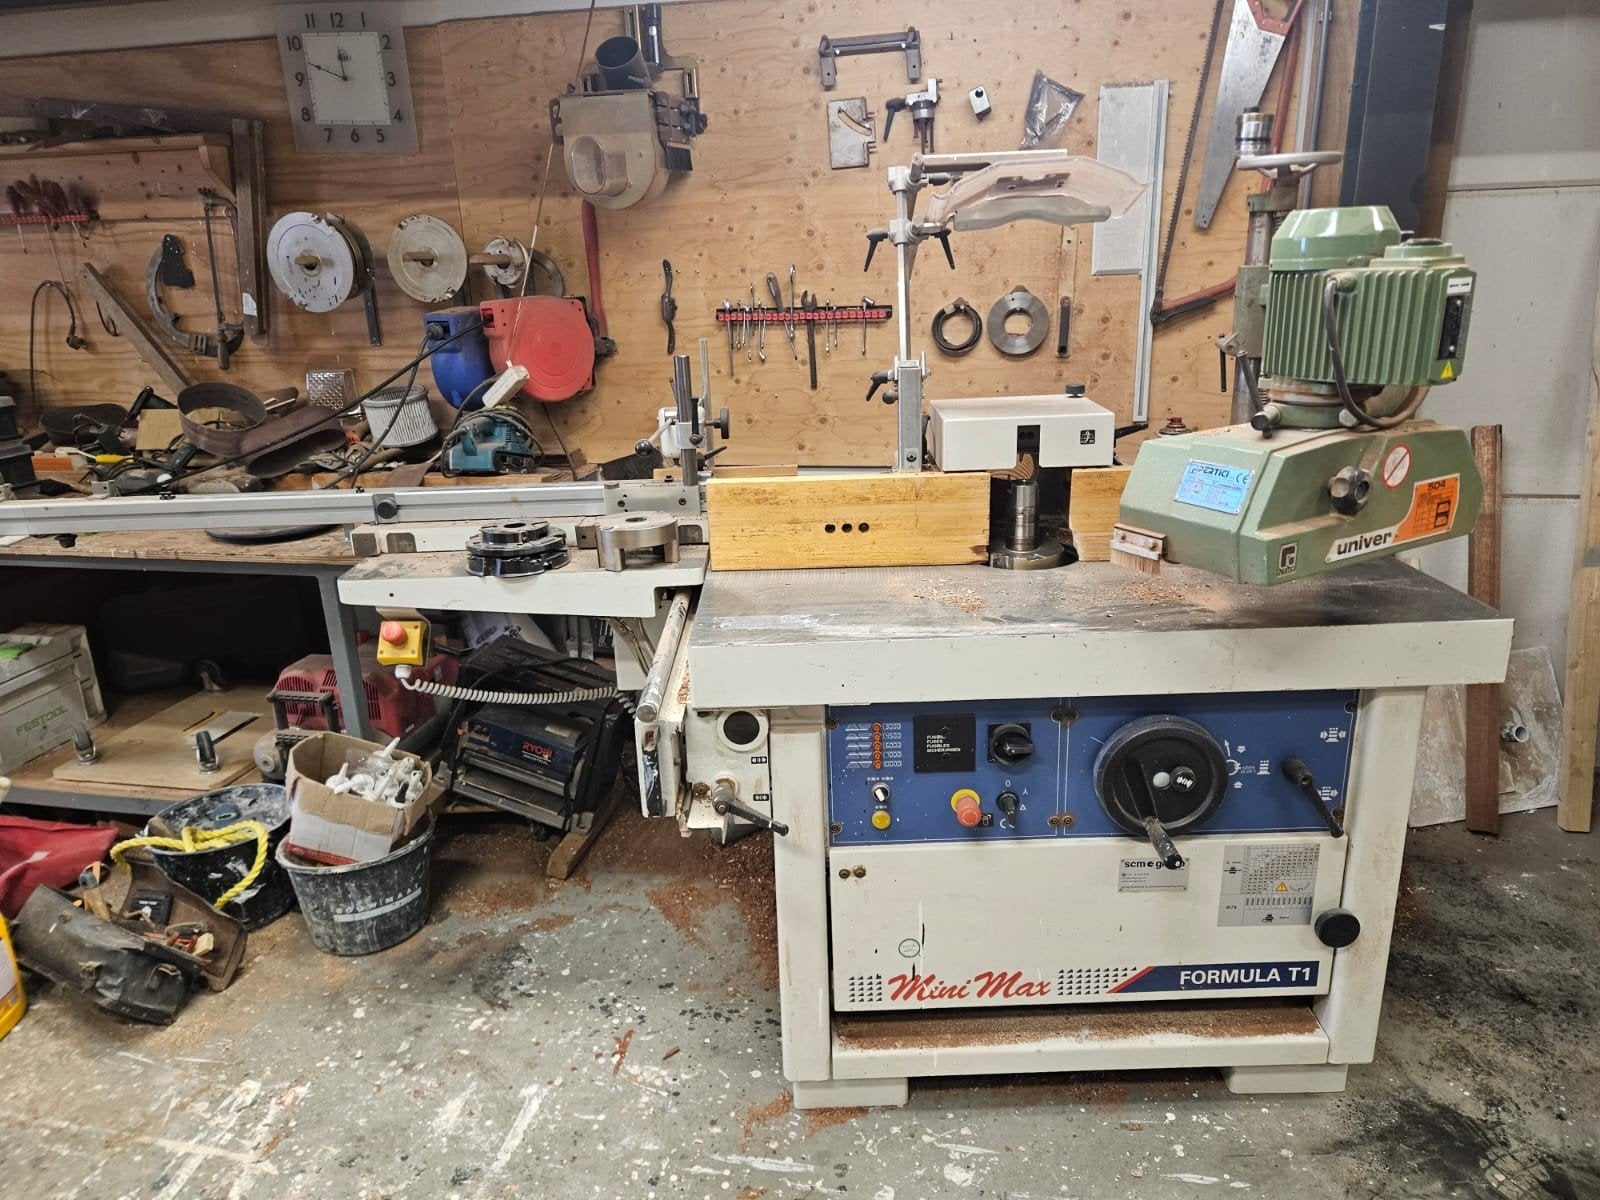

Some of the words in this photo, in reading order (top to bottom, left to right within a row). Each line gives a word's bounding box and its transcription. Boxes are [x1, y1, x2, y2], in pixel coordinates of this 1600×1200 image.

[305, 12, 316, 29] 11
[330, 12, 344, 28] 12
[361, 12, 366, 28] 1
[286, 35, 301, 52] 10
[382, 34, 392, 50] 2
[295, 71, 304, 87] 9
[387, 71, 396, 87] 3
[301, 106, 311, 122] 8
[393, 109, 402, 123] 4
[324, 128, 333, 143] 7
[350, 128, 360, 143] 6
[376, 128, 385, 143] 5
[1427, 480, 1446, 491] 504
[1337, 531, 1392, 555] univer
[16, 706, 69, 736] FESTOOL
[522, 741, 553, 758] RYOBI
[1180, 967, 1281, 985] FORMULA
[1288, 967, 1310, 982] T1
[888, 974, 970, 1001] Mini
[974, 971, 1051, 998] Max
